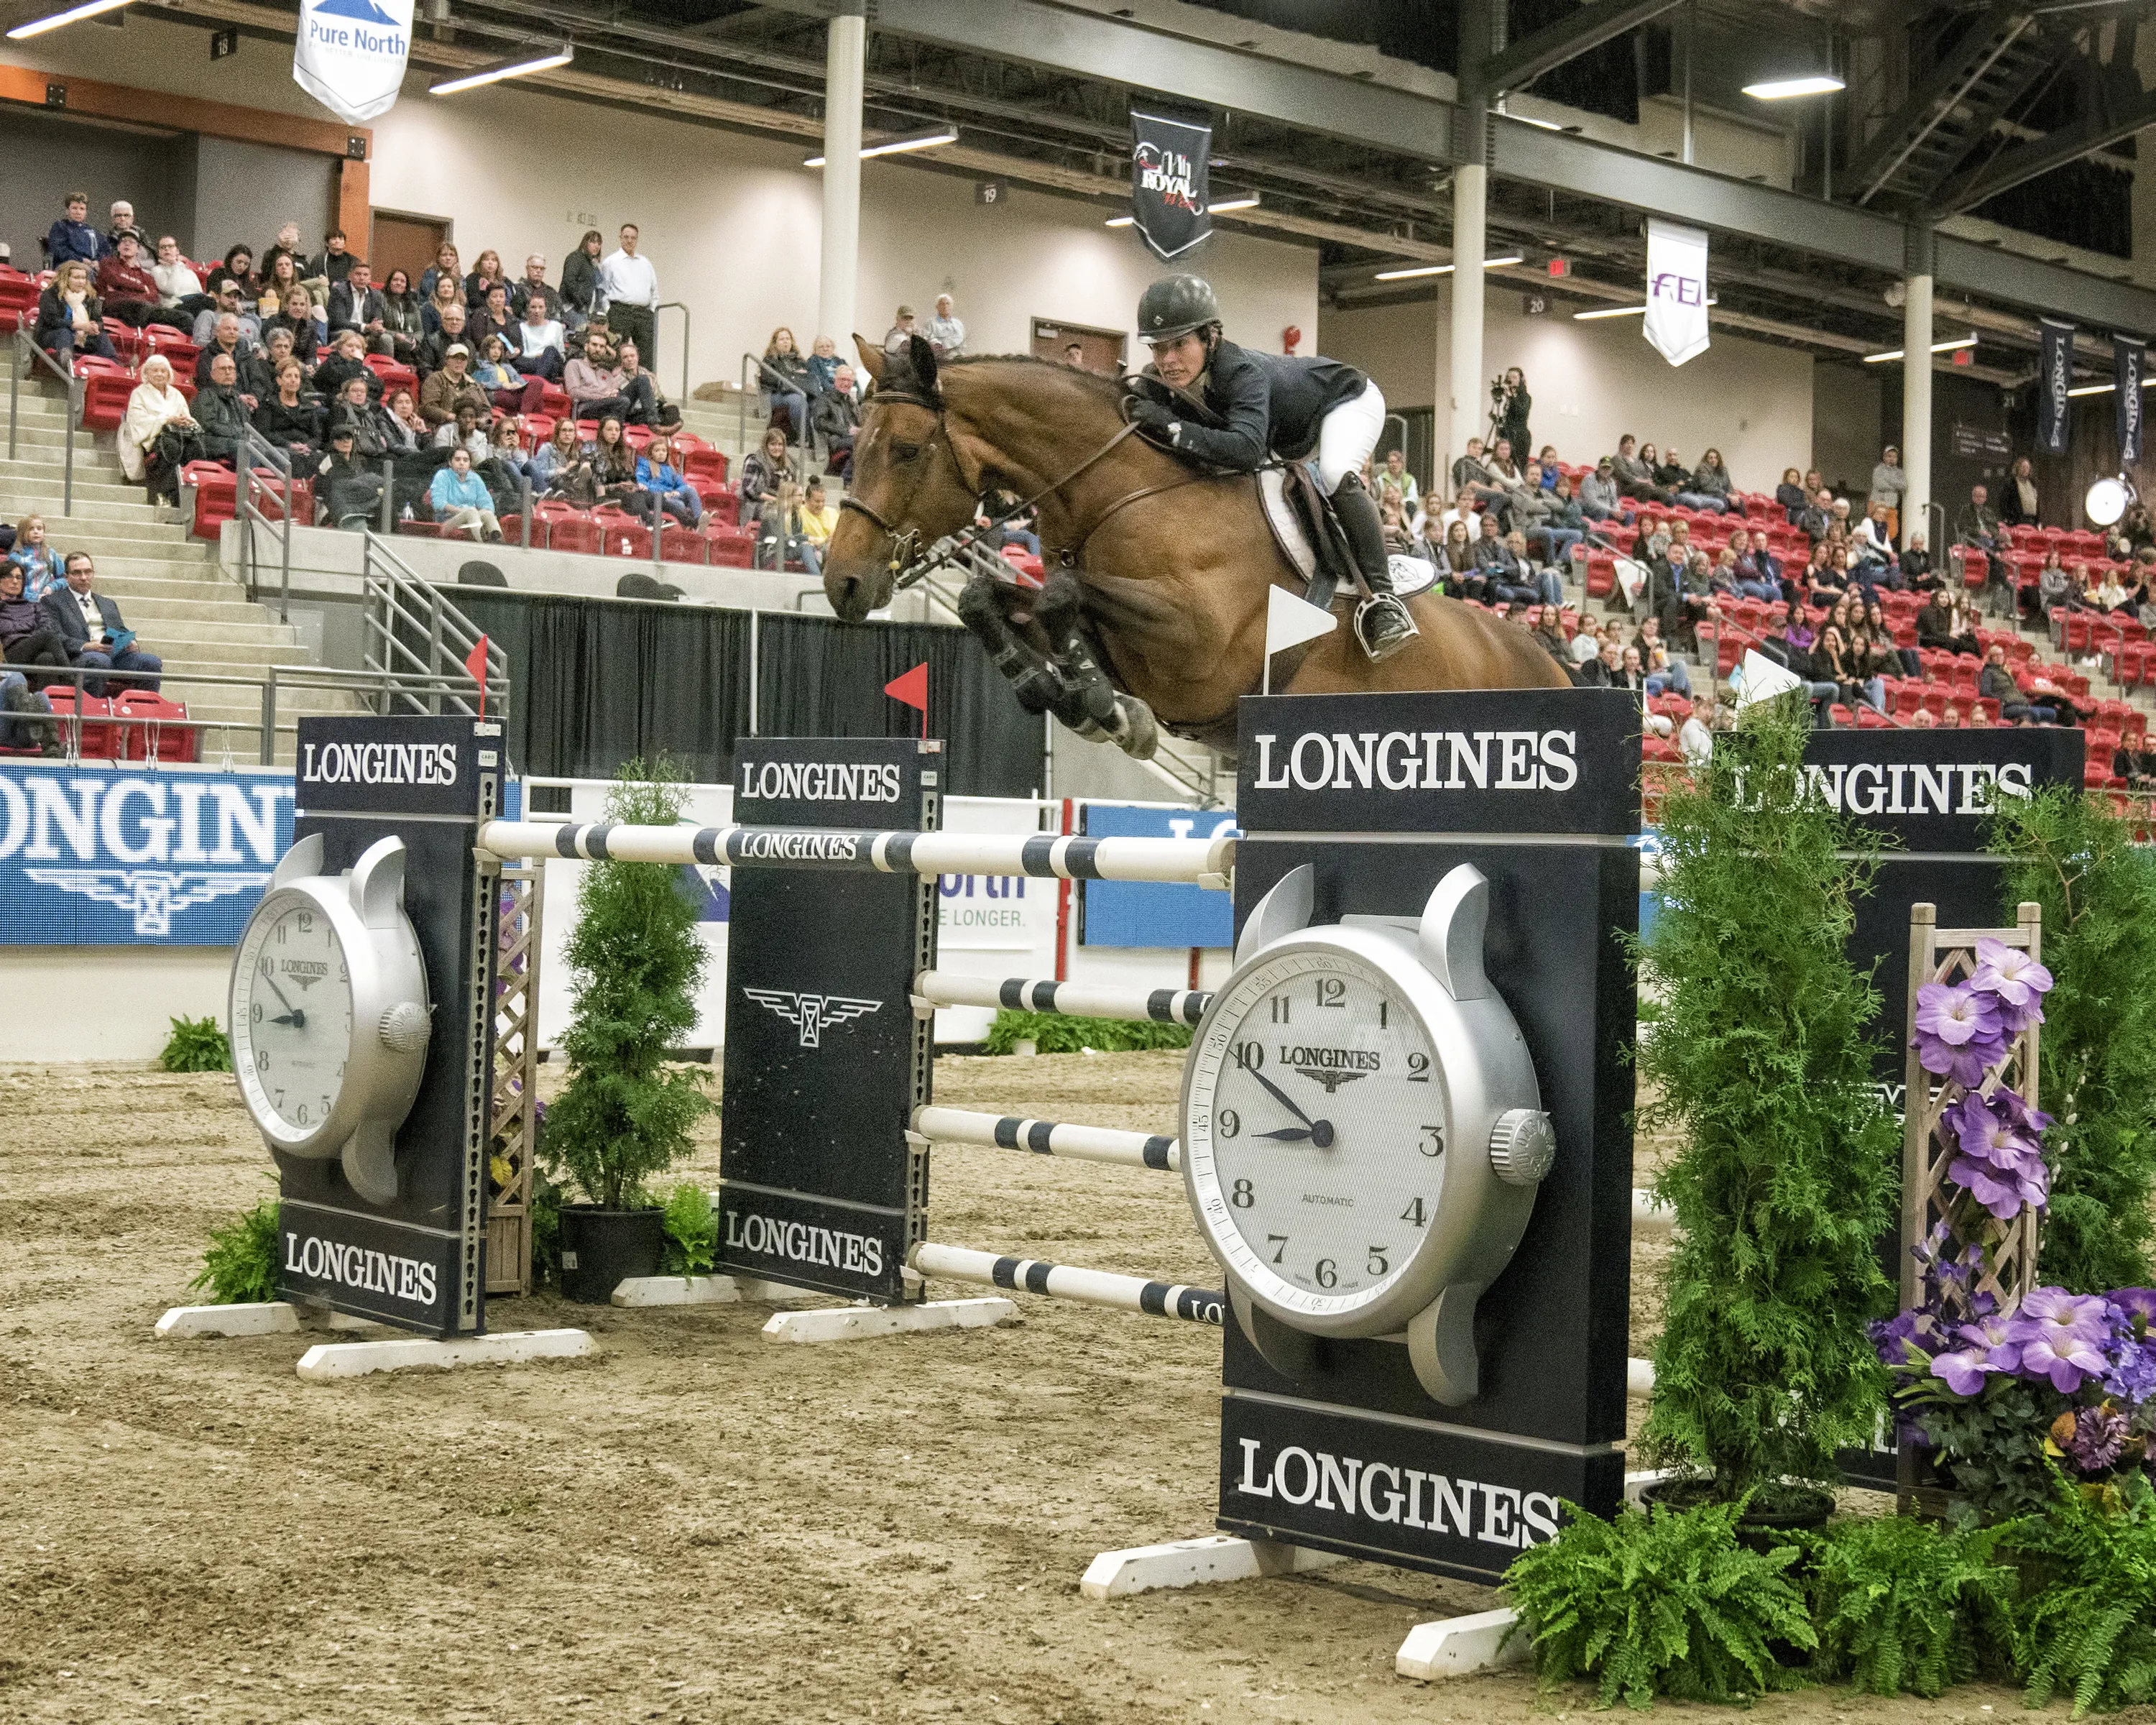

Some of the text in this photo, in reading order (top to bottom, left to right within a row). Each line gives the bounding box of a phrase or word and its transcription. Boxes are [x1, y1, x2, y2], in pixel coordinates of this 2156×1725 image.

[310, 19, 406, 55] Pure North
[984, 188, 997, 203] 19
[1141, 170, 1198, 197] ROYAL
[1530, 300, 1544, 313] 20
[303, 742, 456, 786] LONGINES
[1254, 730, 1578, 791] LONGINES
[741, 762, 900, 803] LONGINES
[740, 832, 862, 860] LONGINES
[297, 913, 313, 933] 12
[954, 909, 1026, 926] LONGER.
[277, 924, 286, 944] 11
[259, 955, 274, 976] 10
[281, 959, 328, 975] LONGINES
[1316, 978, 1345, 1008] 12
[253, 1003, 263, 1023] 9
[1269, 995, 1289, 1024] 11
[1378, 1000, 1388, 1030] 1
[259, 1051, 270, 1071] 8
[1235, 1041, 1264, 1070] 10
[1279, 1045, 1381, 1071] LONGINES
[1407, 1052, 1429, 1082] 2
[275, 1088, 285, 1108] 7
[321, 1094, 331, 1115] 5
[297, 1104, 308, 1125] 6
[1219, 1109, 1240, 1138] 9
[1419, 1125, 1444, 1157] 3
[1232, 1179, 1255, 1208] 8
[1302, 1193, 1354, 1208] AUTOMATIC
[1399, 1197, 1427, 1226] 4
[726, 1212, 883, 1276] LONGINES
[1267, 1234, 1289, 1264] 7
[285, 1233, 437, 1306] LONGINES
[1315, 1259, 1337, 1289] 6
[1367, 1246, 1388, 1276] 5
[1238, 1438, 1560, 1550] LONGINES
